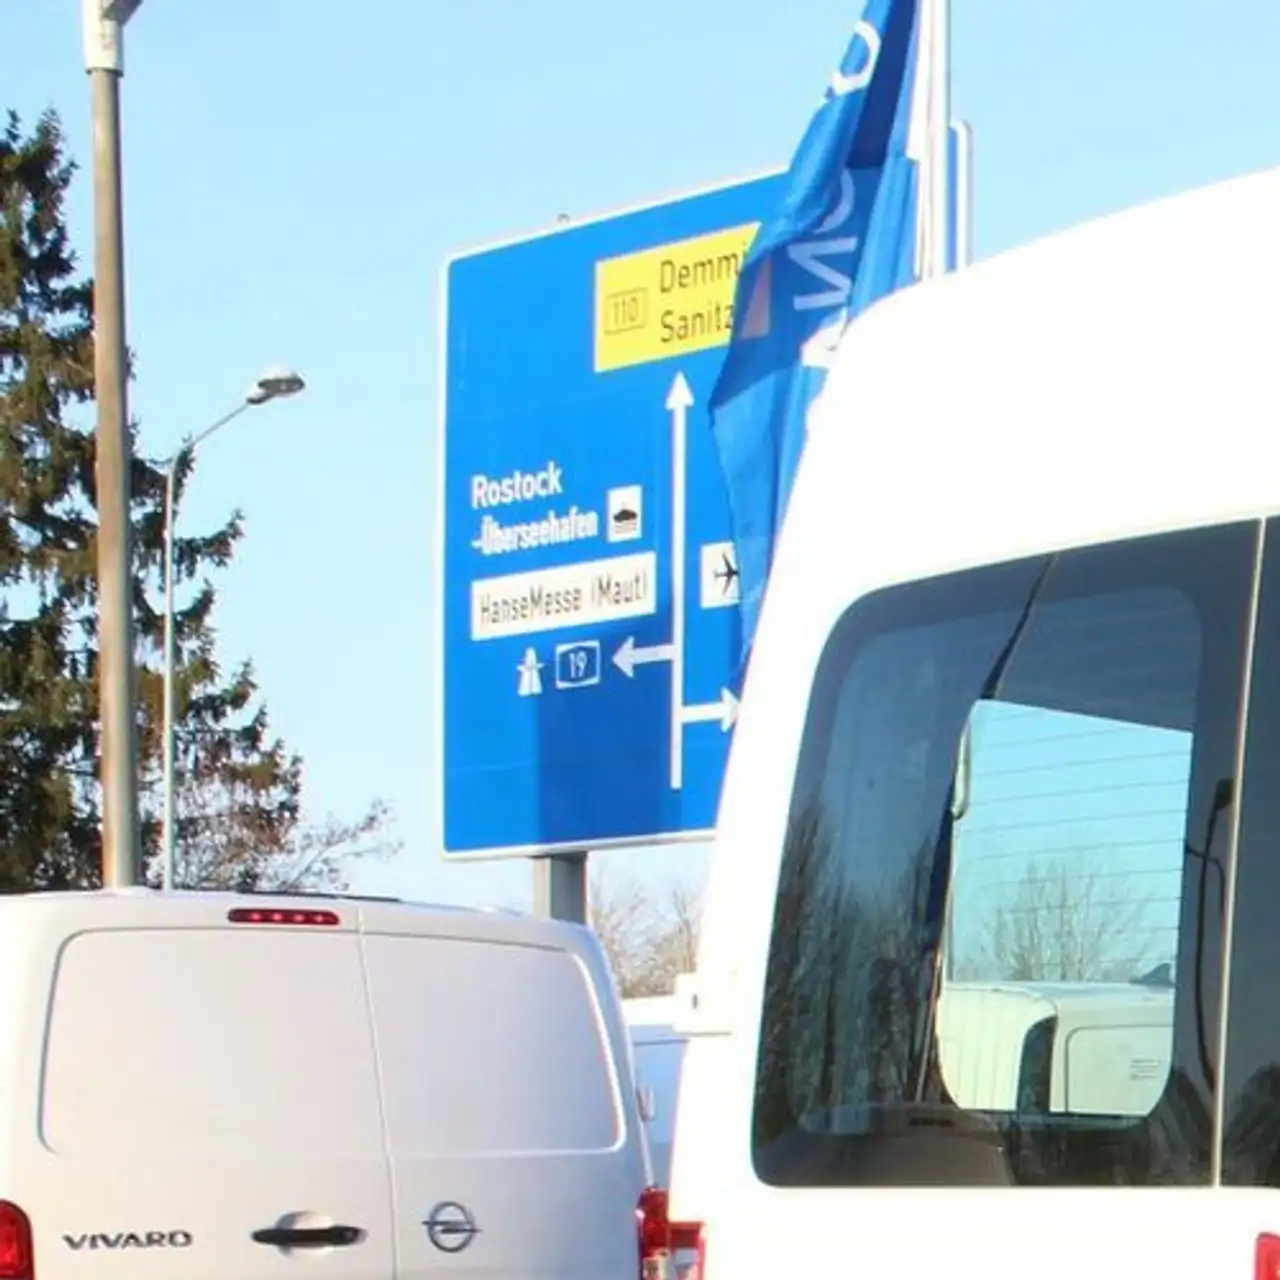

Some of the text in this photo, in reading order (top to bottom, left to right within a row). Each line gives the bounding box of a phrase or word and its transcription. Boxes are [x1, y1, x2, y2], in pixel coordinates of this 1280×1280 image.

[613, 296, 639, 327] 110
[472, 460, 563, 510] Rostock
[479, 567, 648, 626] HanseMesse (Maut)
[568, 651, 588, 679] 19
[62, 1230, 193, 1250] VIVARO
